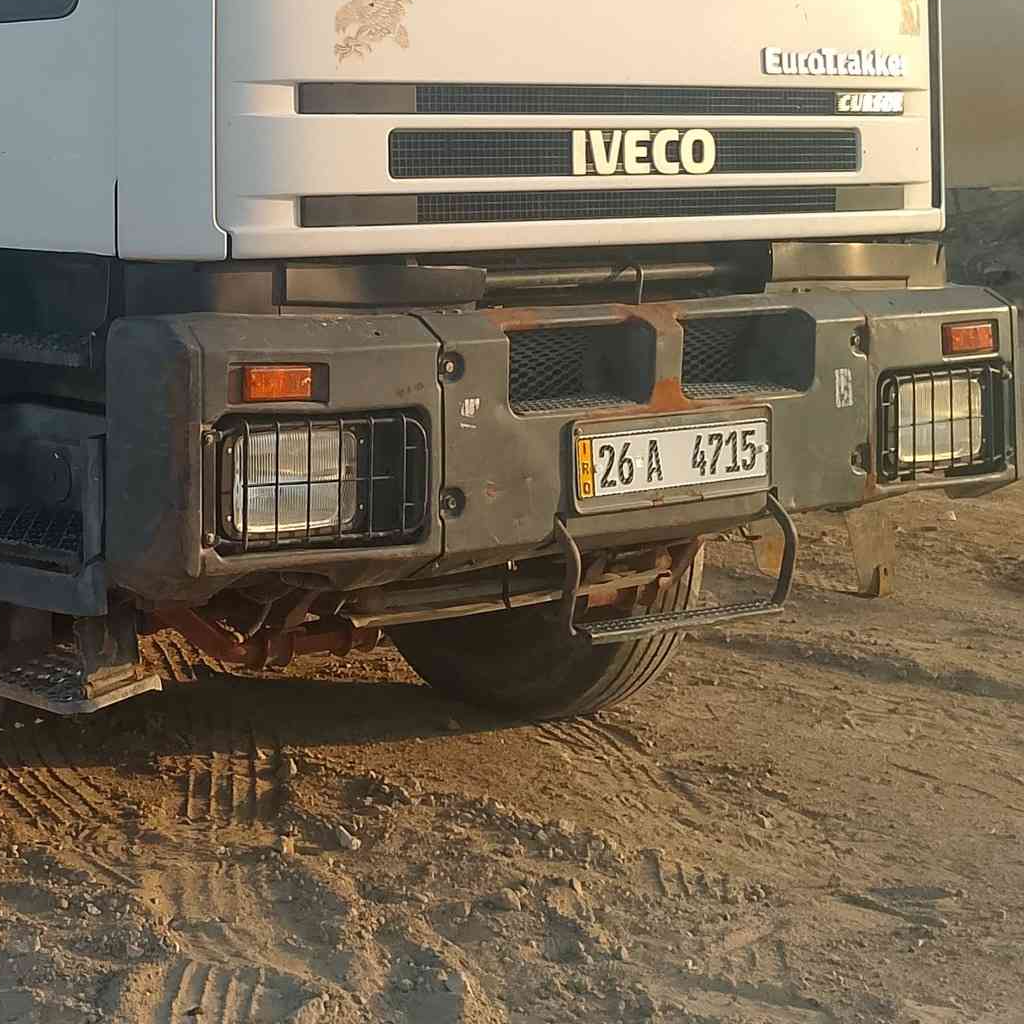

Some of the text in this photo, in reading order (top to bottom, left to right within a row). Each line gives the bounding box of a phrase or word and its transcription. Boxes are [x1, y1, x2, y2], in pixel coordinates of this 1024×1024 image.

[761, 47, 907, 77] EuroTrakke
[571, 128, 717, 175] IVECO
[598, 430, 756, 488] 26 A 4715
